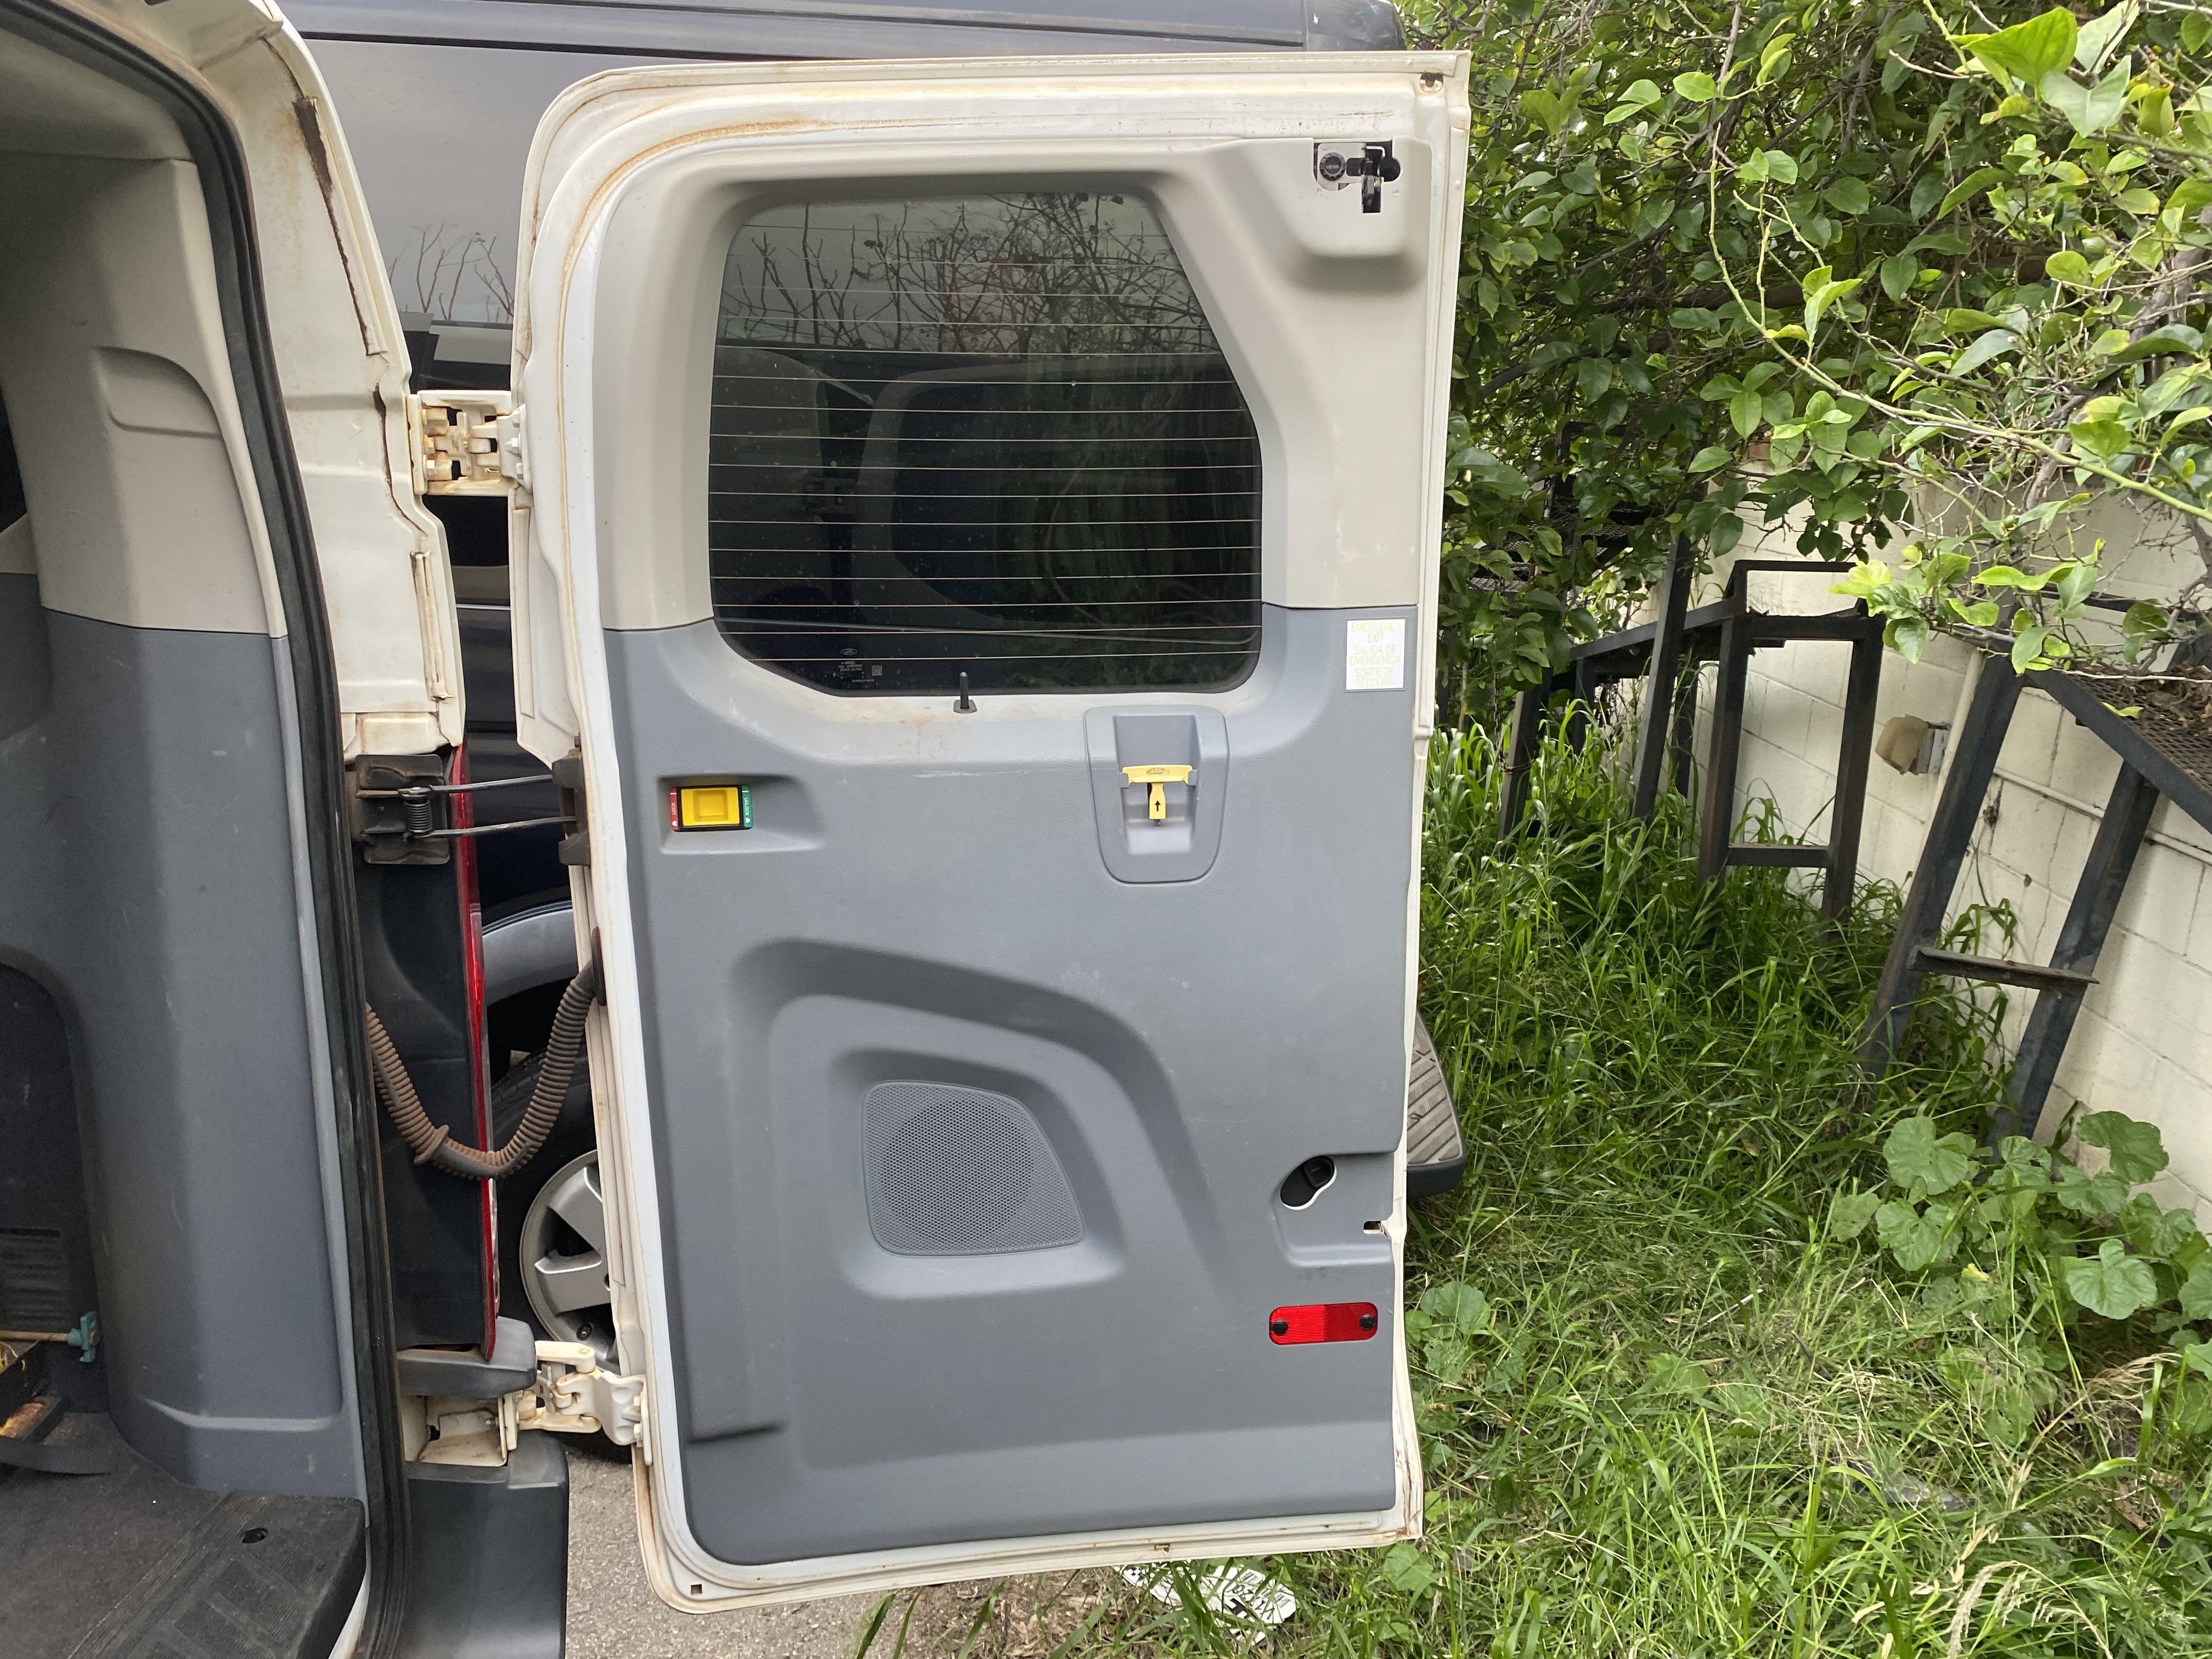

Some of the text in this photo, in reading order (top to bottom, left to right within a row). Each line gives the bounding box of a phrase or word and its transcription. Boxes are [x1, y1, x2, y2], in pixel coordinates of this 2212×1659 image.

[1351, 622, 1400, 633] EMERGENCY
[1368, 632, 1384, 642] EXIT
[1355, 644, 1396, 655] SALIDA DE
[1350, 655, 1401, 665] EMERGENCIA
[1355, 667, 1394, 678] SORTIE DE
[1356, 677, 1393, 687] SECOURS
